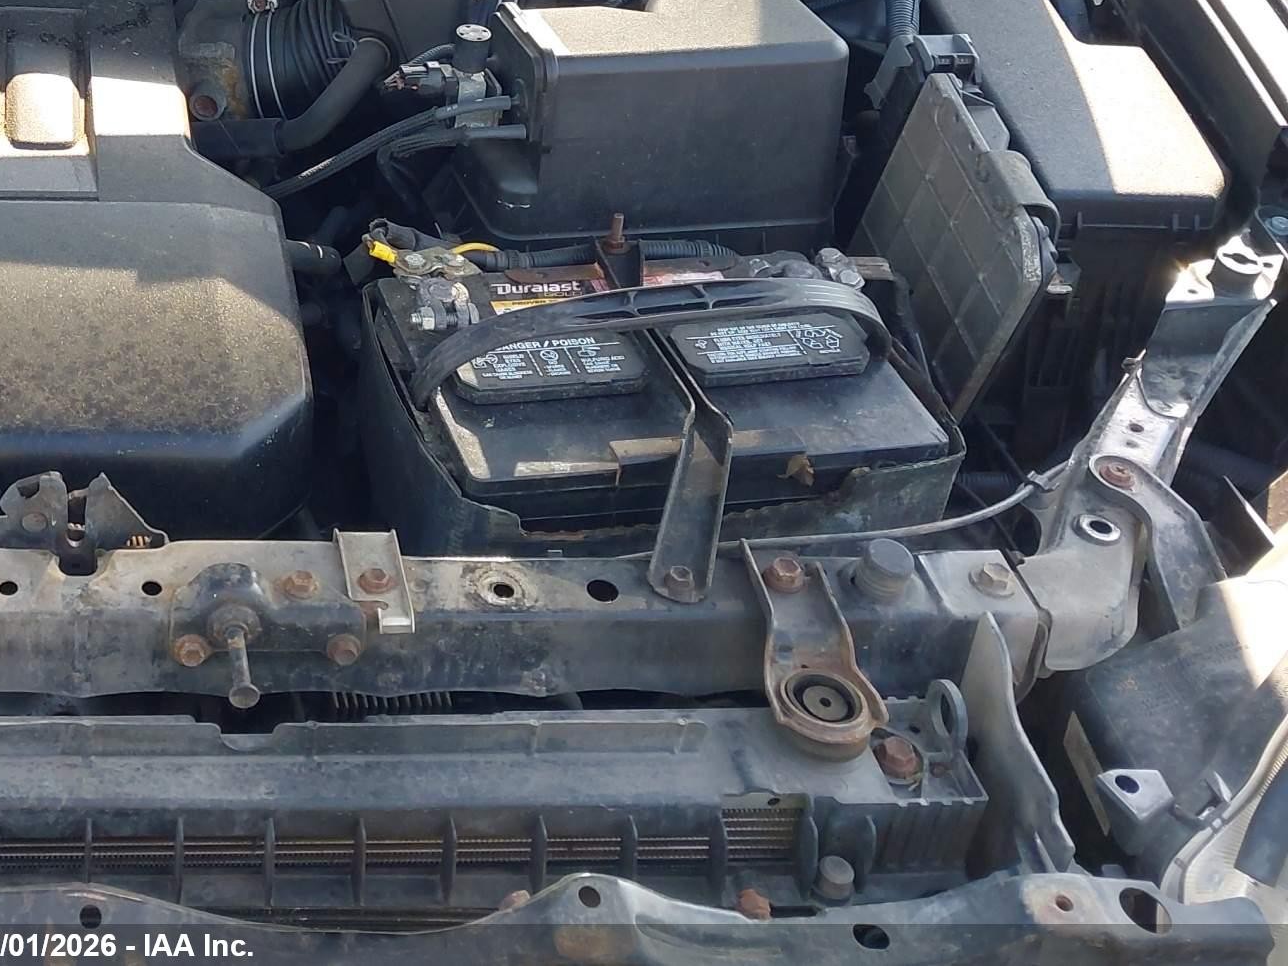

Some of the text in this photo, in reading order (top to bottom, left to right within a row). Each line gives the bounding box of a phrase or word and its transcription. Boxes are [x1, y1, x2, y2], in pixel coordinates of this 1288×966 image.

[491, 280, 581, 295] Duralast
[543, 340, 550, 348] /
[551, 337, 596, 347] POISON
